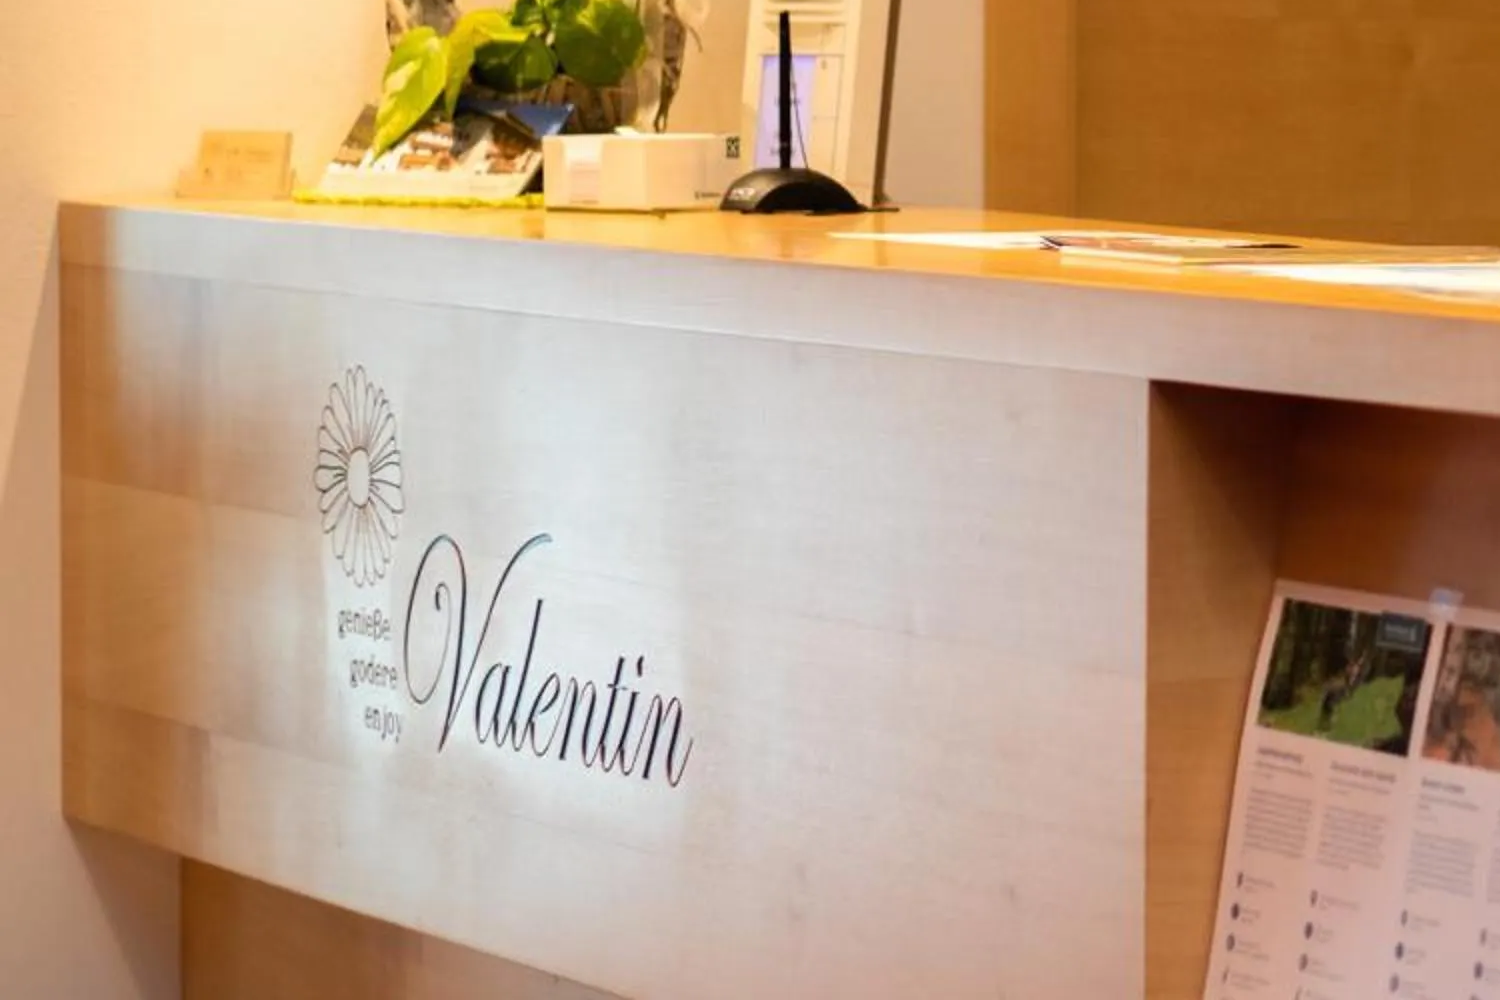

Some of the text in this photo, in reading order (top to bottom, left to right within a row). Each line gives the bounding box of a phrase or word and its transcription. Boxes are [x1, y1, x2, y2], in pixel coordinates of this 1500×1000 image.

[338, 608, 391, 641] genieße
[350, 654, 398, 689] godere
[404, 533, 694, 788] Valentin
[365, 705, 402, 744] enjoy
